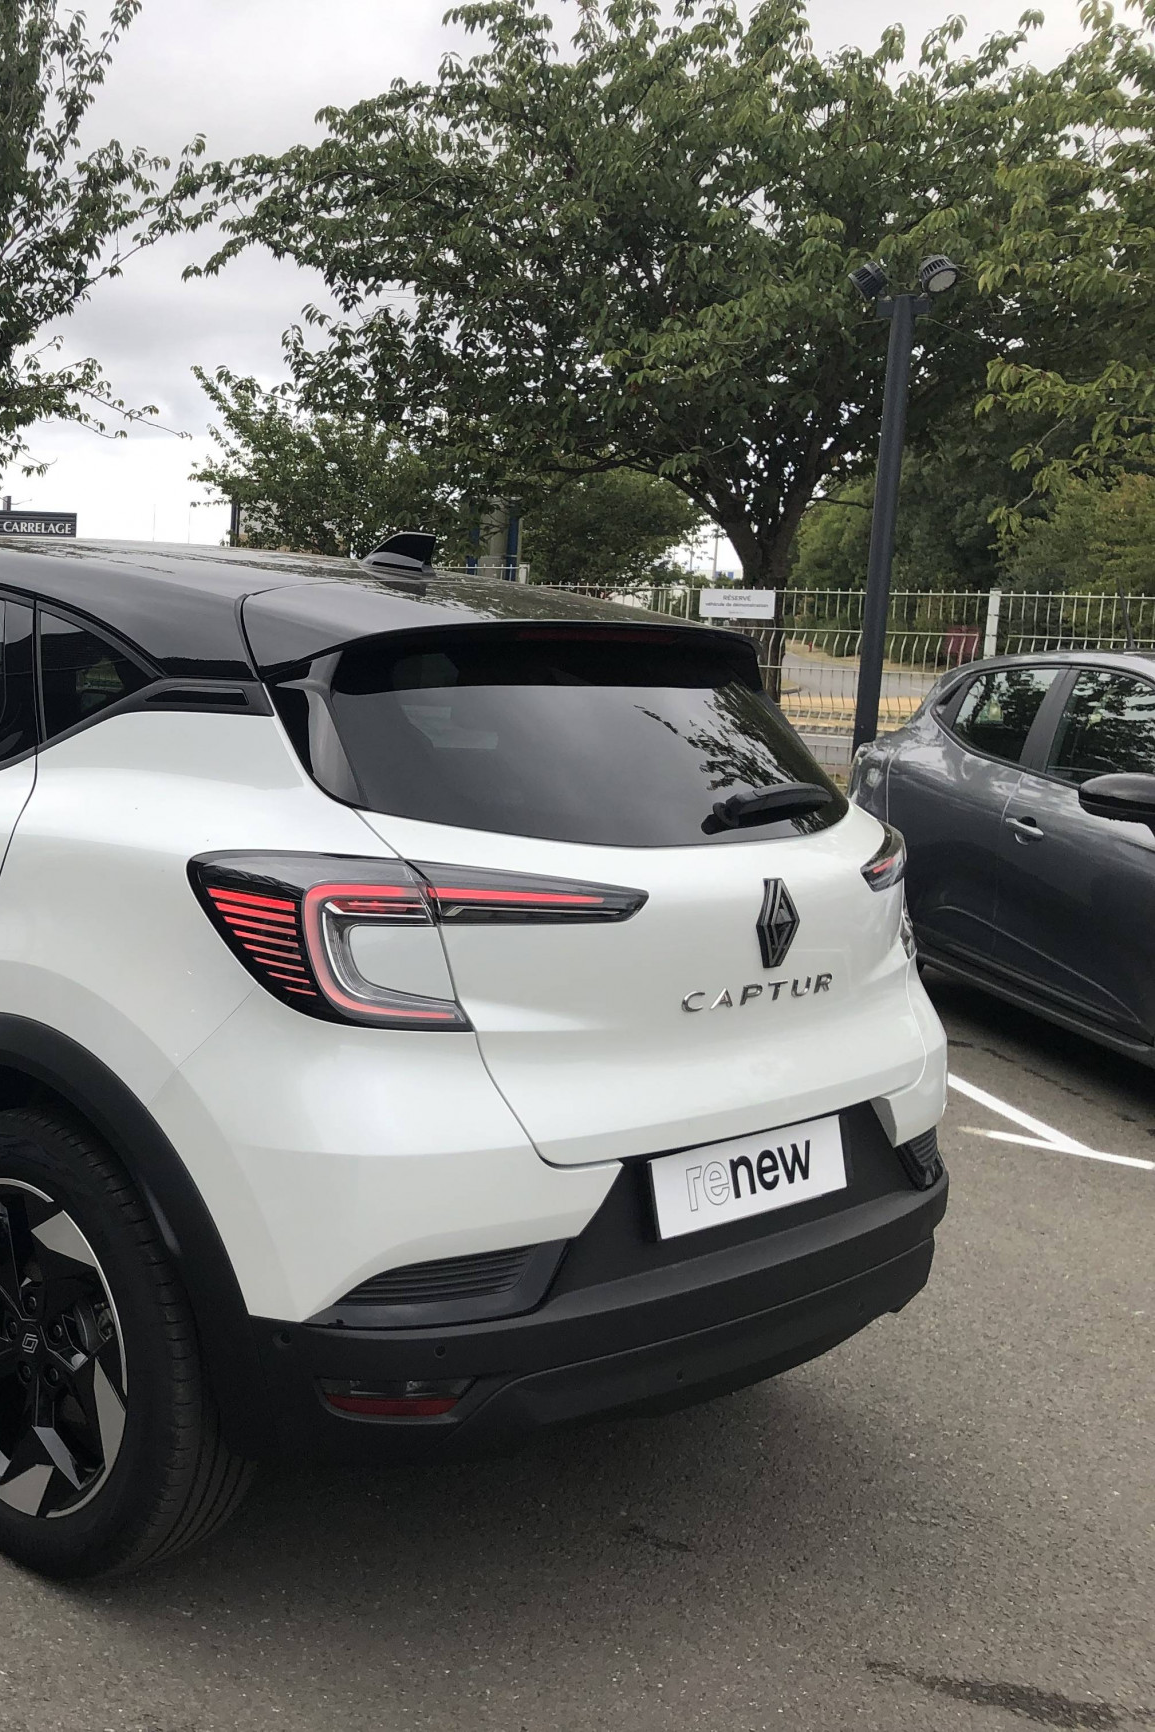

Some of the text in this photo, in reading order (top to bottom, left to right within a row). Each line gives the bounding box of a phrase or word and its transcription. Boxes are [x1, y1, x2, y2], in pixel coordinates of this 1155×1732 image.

[3, 521, 72, 534] CARRELAGE
[681, 973, 833, 1012] CAPTUR
[685, 1139, 811, 1212] renew
